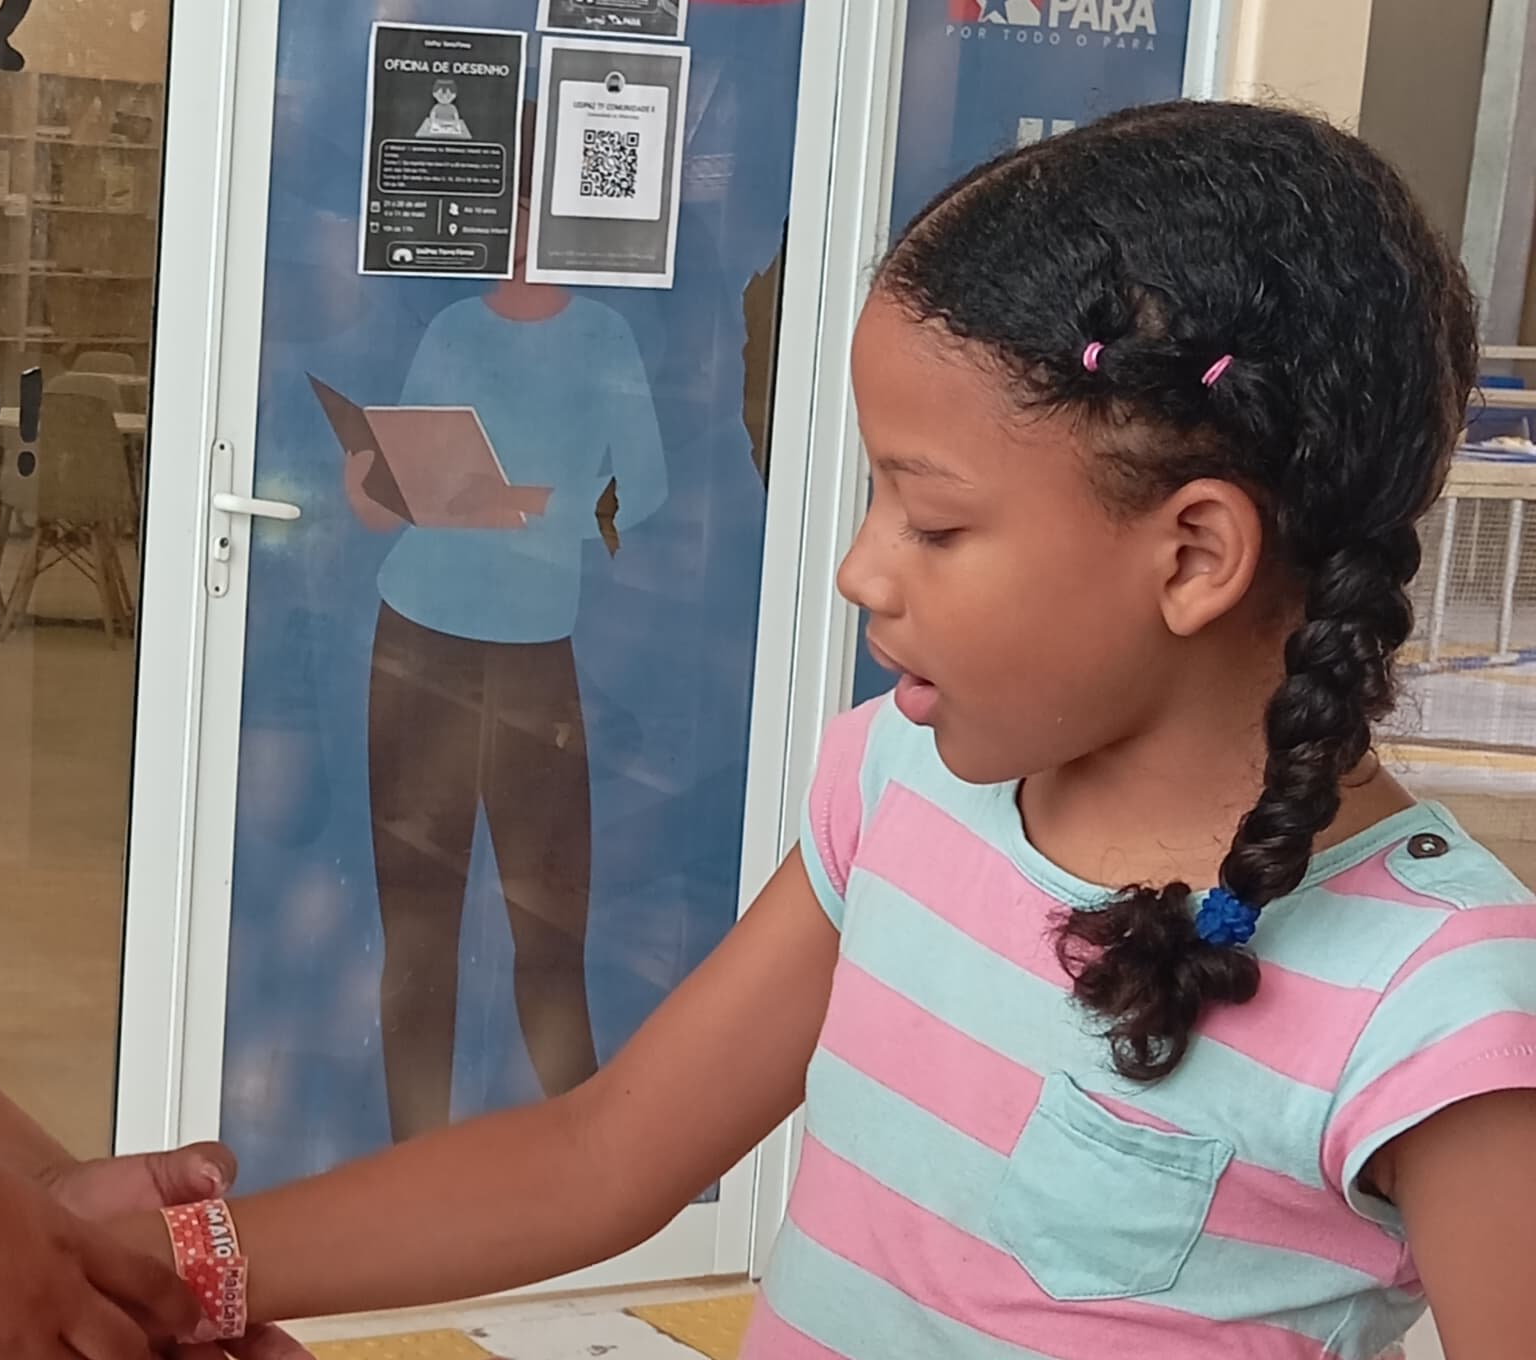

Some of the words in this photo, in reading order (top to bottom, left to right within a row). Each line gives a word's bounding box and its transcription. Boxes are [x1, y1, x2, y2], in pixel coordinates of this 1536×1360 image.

[946, 24, 986, 39] POR
[1004, 29, 1061, 45] TODO
[1076, 35, 1088, 47] O
[384, 58, 429, 73] OFICINA
[432, 61, 449, 73] DE
[453, 62, 510, 77] DESENHO
[205, 1204, 237, 1259] MAIO
